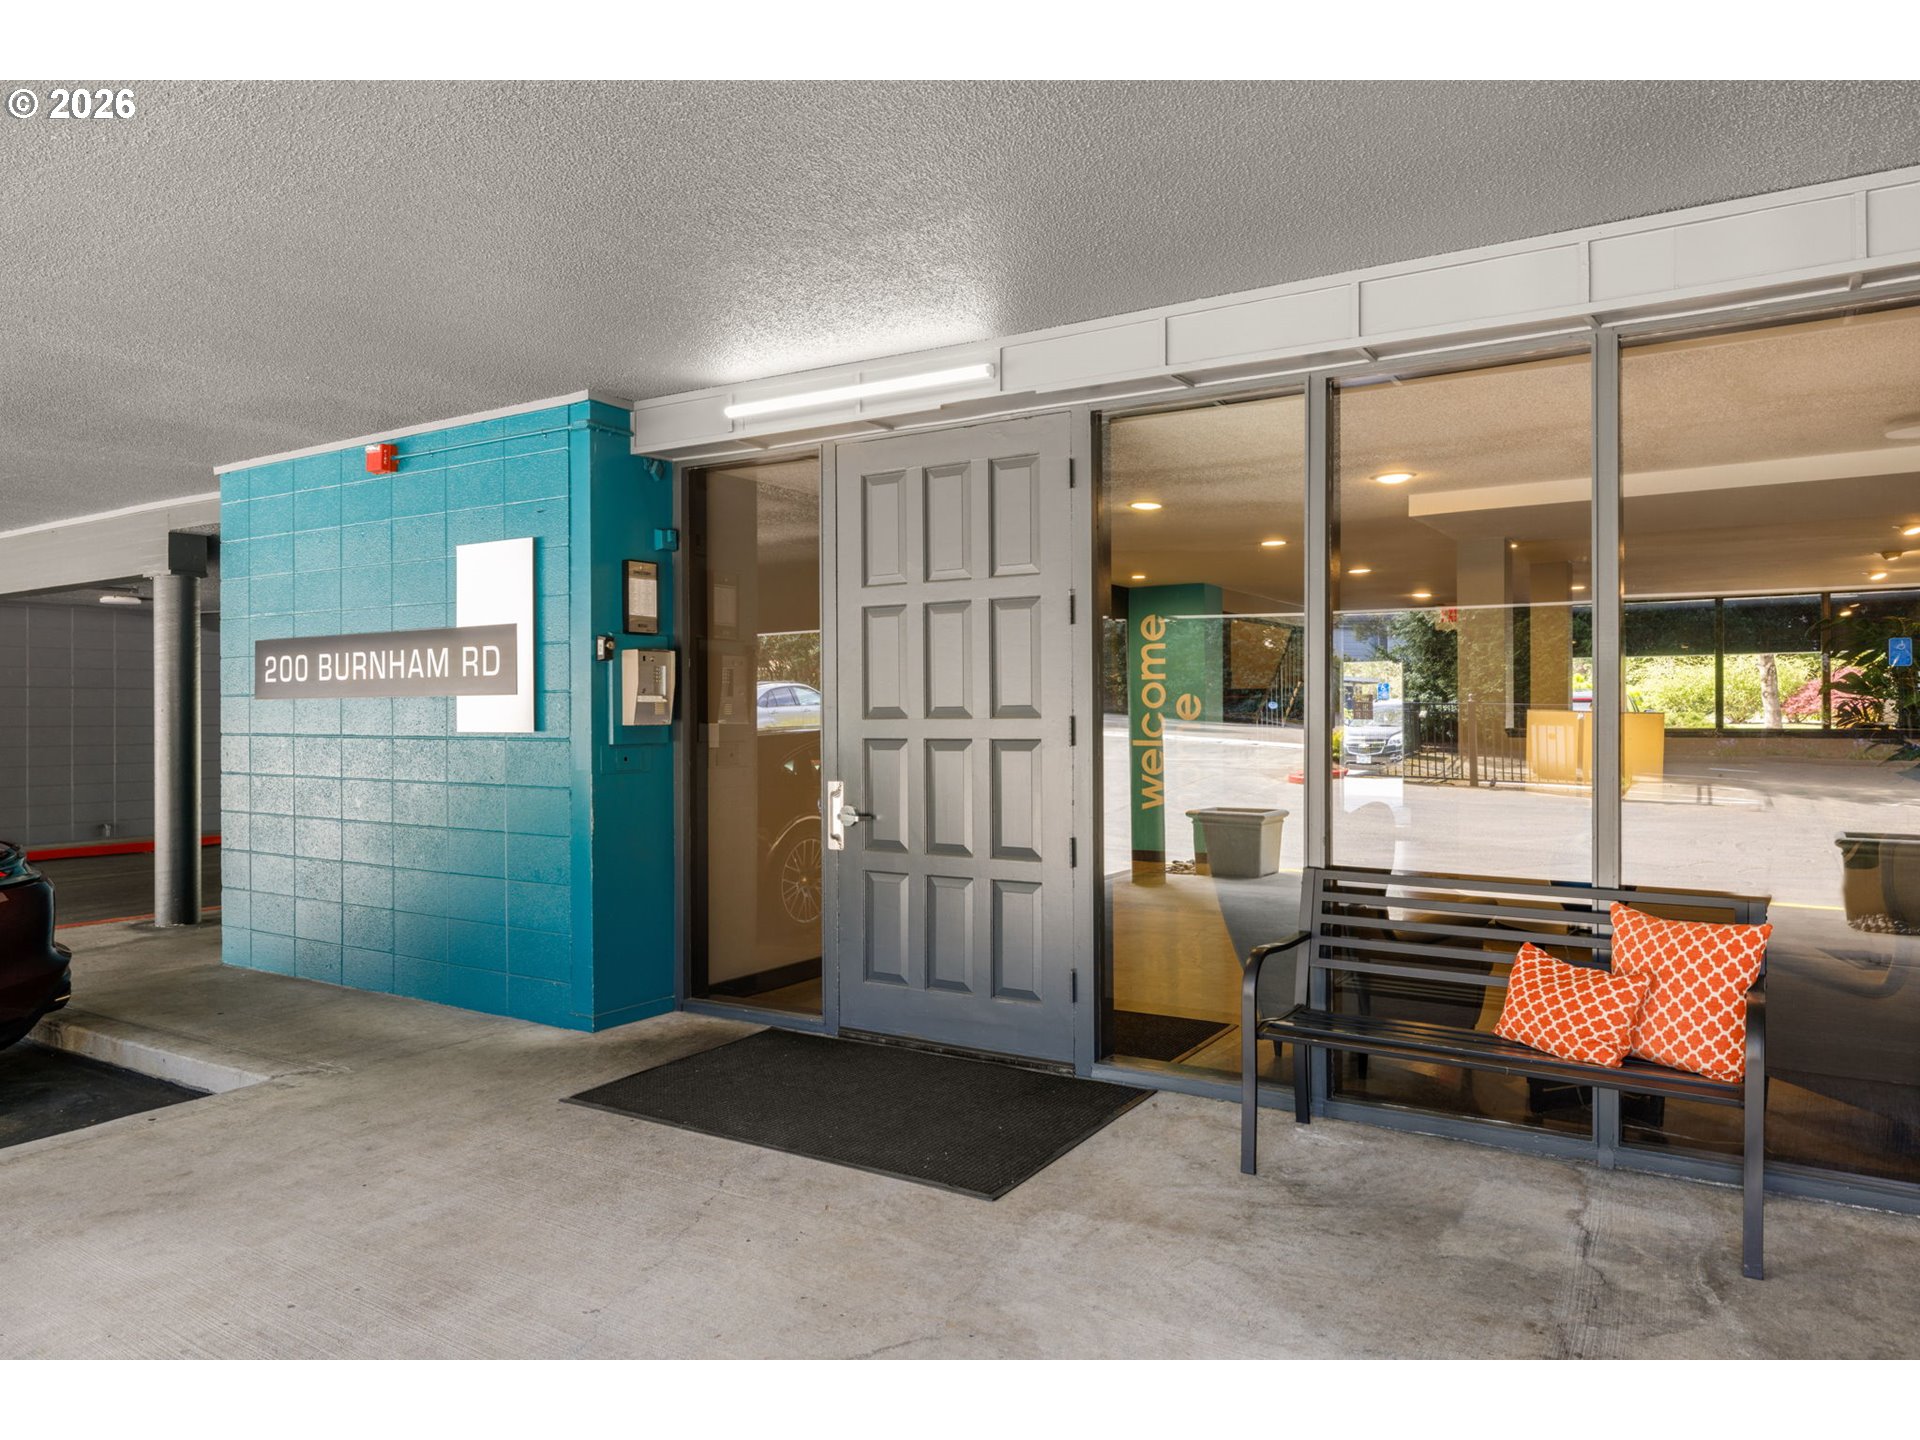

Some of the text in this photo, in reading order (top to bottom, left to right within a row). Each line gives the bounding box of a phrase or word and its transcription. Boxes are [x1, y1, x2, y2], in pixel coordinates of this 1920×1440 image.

[264, 645, 501, 683] 200 BURNHAM RD
[1132, 614, 1167, 810] welcome
